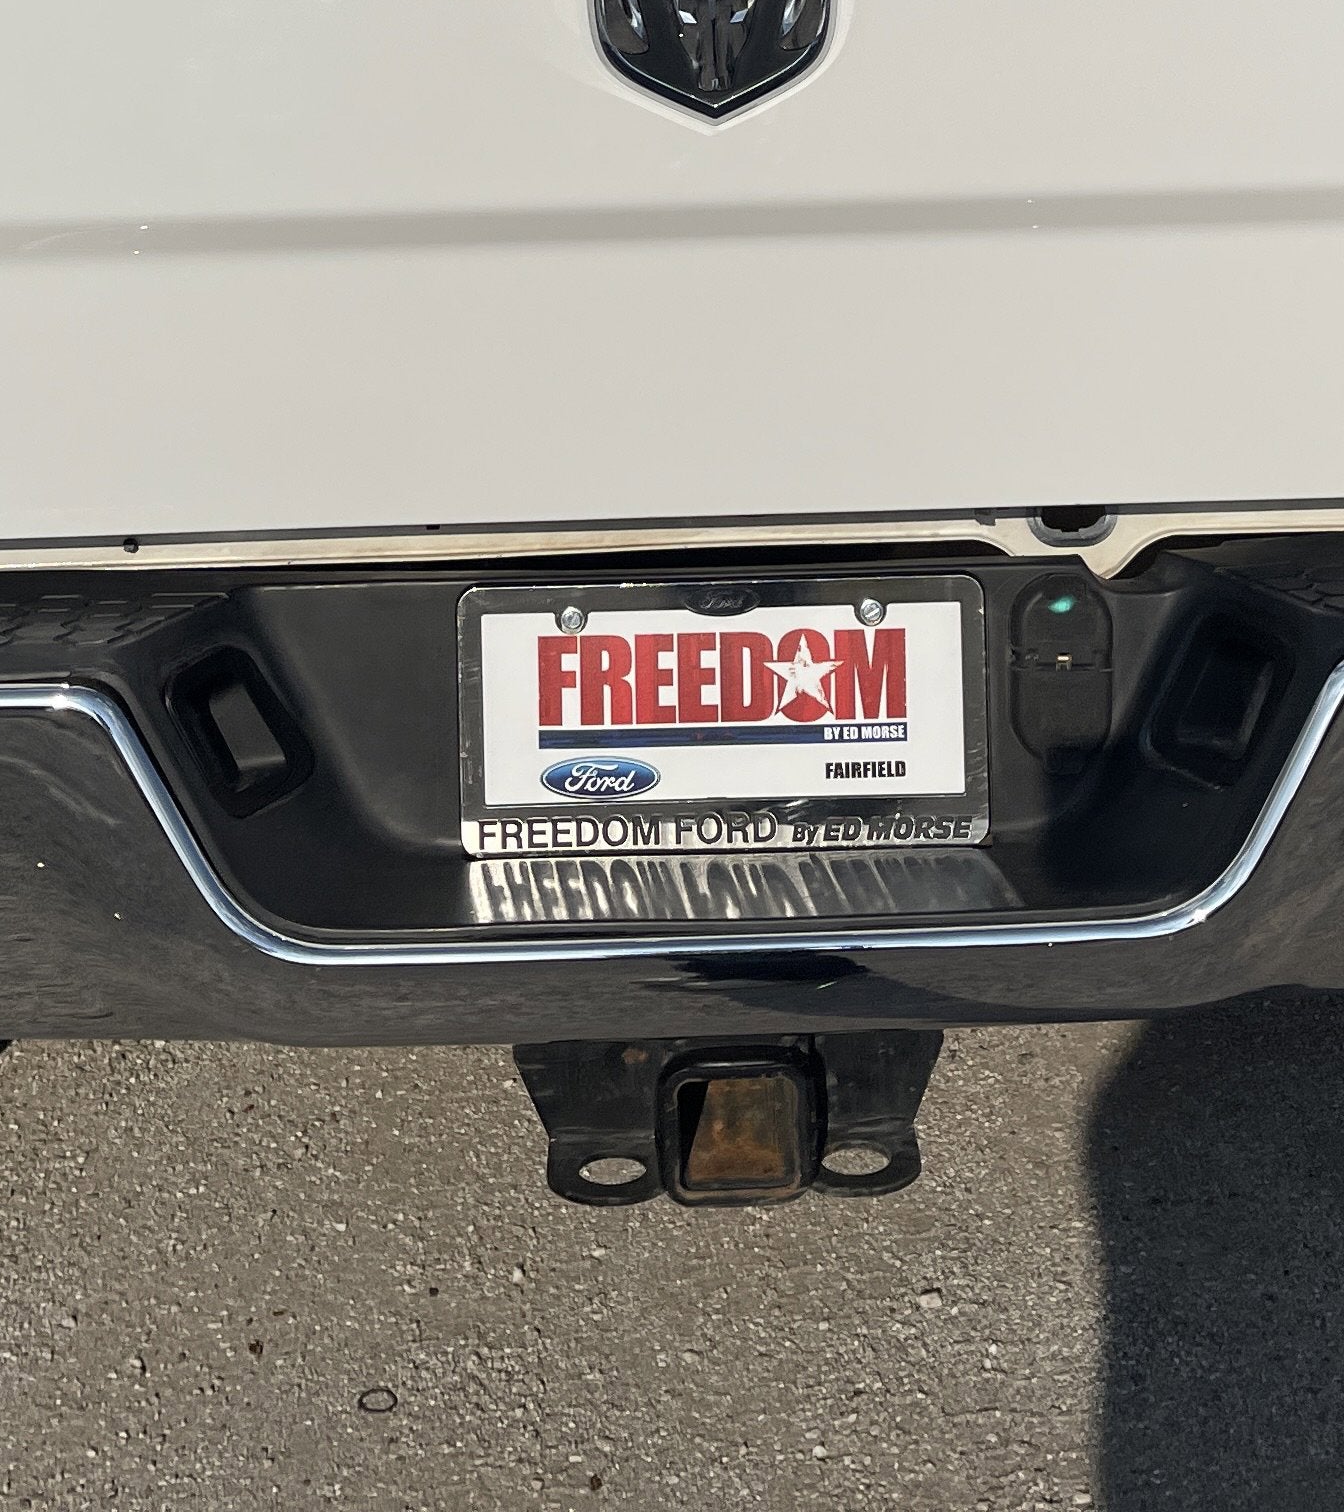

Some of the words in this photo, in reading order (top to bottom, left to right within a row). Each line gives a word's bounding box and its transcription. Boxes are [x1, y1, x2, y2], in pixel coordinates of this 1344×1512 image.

[538, 628, 907, 726] FREEDOM
[824, 726, 840, 740] BY
[843, 726, 858, 739] ED
[861, 724, 905, 739] MORSE
[564, 762, 637, 792] Ford
[825, 760, 906, 779] FAIRFIELD
[478, 815, 662, 850] FREEDOM
[675, 811, 779, 845] FORD
[824, 815, 864, 842] ED
[866, 813, 973, 841] MORSE
